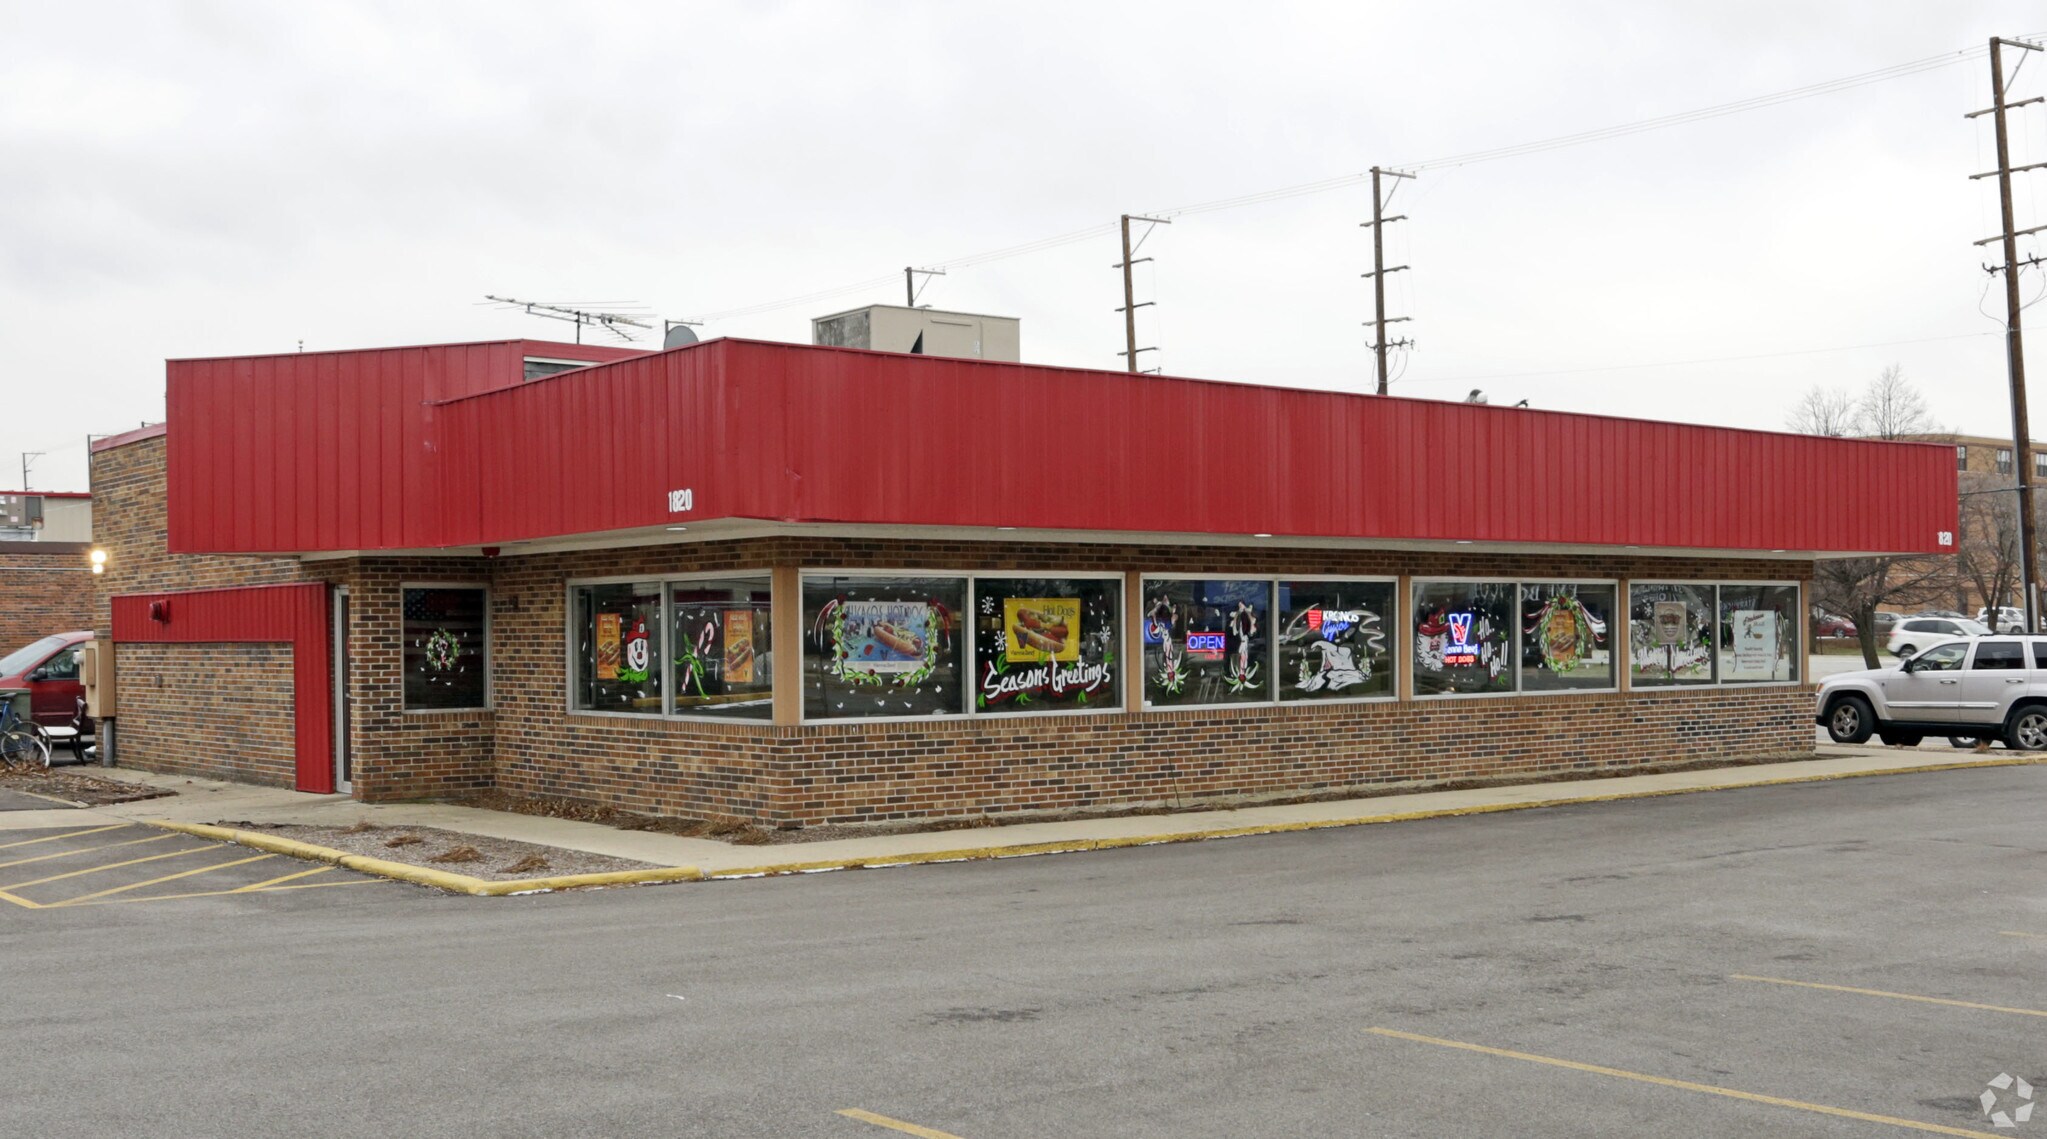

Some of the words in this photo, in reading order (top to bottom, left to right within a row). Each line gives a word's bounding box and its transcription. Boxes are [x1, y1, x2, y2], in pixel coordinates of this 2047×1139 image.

[668, 488, 692, 512] 1820
[1043, 605, 1056, 616] Hot
[1057, 605, 1075, 617] Dogs
[1322, 610, 1359, 622] KRONOS
[1188, 635, 1225, 649] OPEN
[984, 660, 1049, 699] Seasons
[1051, 650, 1111, 693] Greetings
